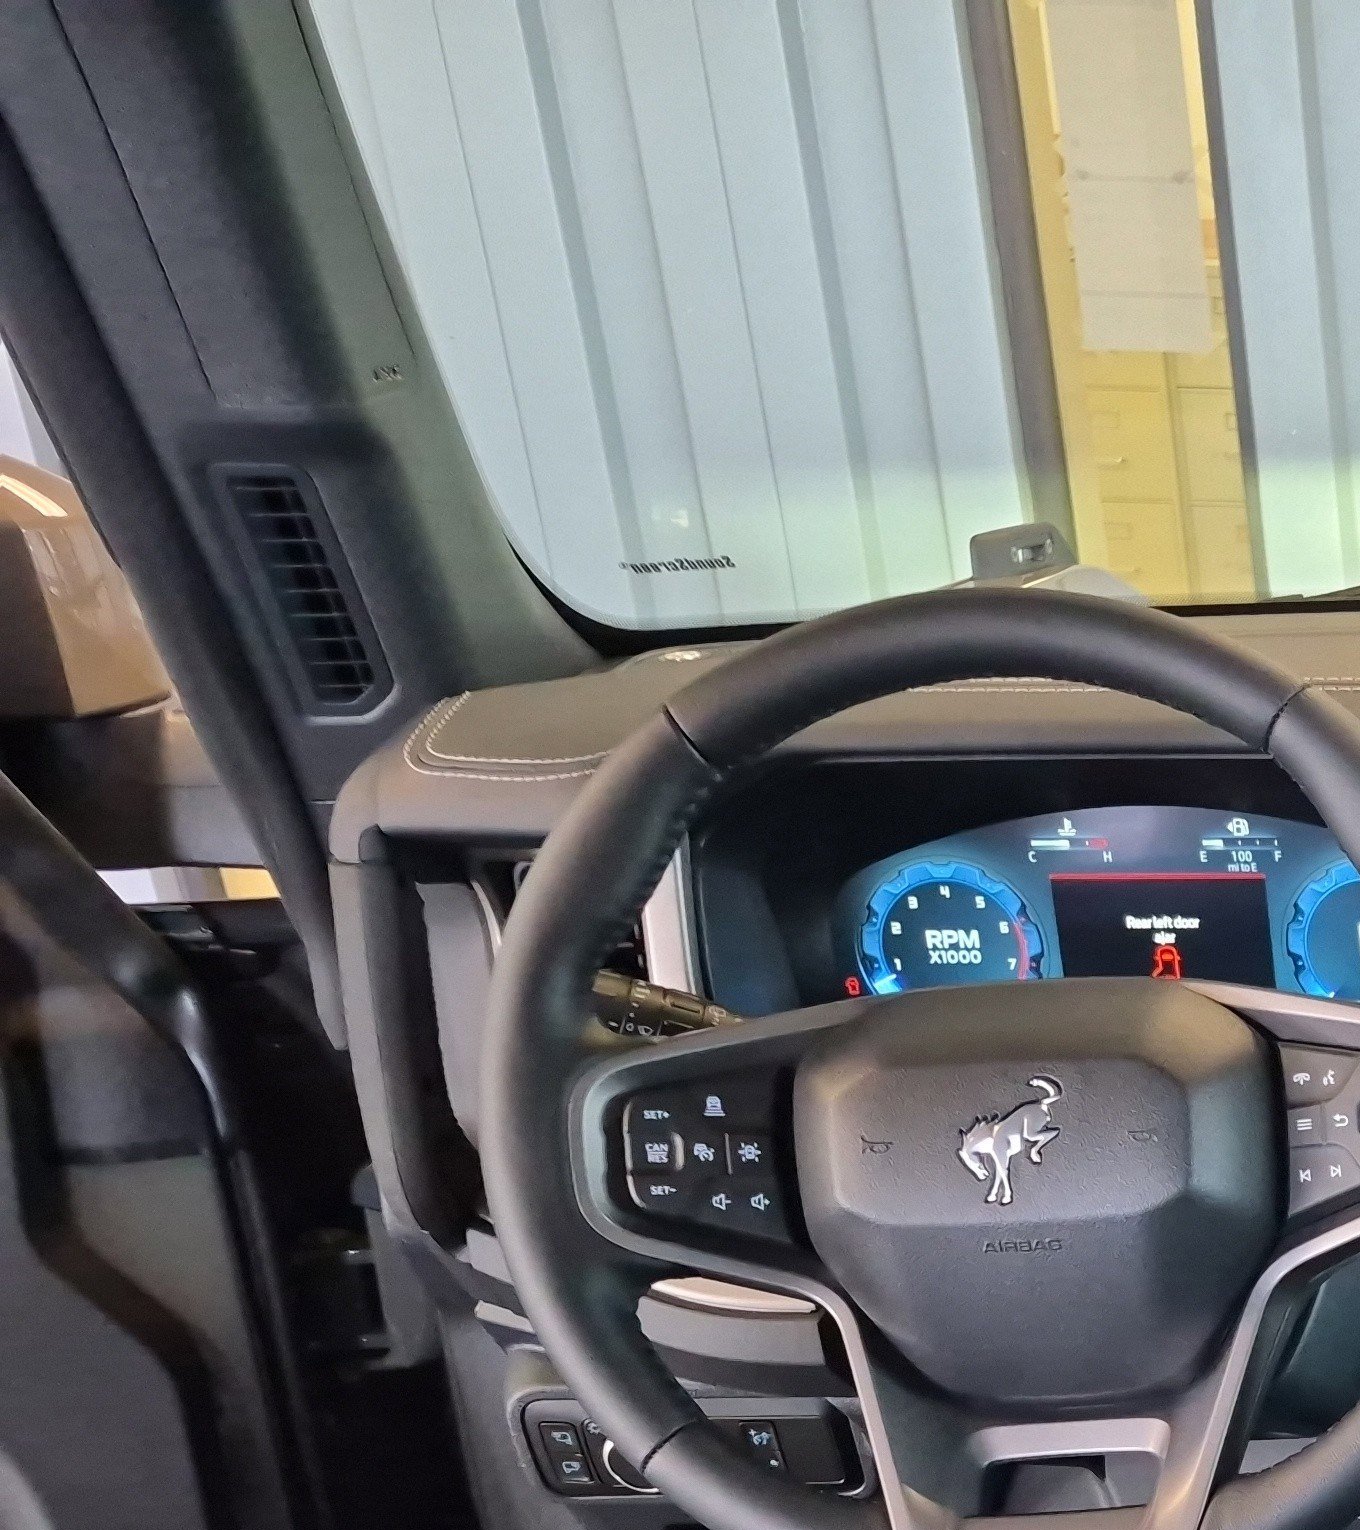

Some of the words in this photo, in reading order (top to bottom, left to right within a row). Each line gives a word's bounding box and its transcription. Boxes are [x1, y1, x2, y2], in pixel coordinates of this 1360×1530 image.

[1028, 852, 1037, 863] C
[1104, 852, 1112, 862] H
[1200, 852, 1207, 862] E
[1231, 851, 1252, 862] 100
[1275, 852, 1281, 862] F
[1241, 863, 1250, 872] to
[1251, 864, 1257, 872] E
[940, 885, 950, 898] 4
[908, 896, 918, 909] 3
[975, 896, 985, 909] 5
[891, 921, 901, 934] 2
[1000, 921, 1009, 934] 6
[1125, 916, 1152, 929] Rear
[1152, 915, 1172, 929] left
[1174, 916, 1200, 929] door
[925, 929, 980, 949] RPM
[929, 950, 982, 964] X1000
[894, 958, 901, 971] 1
[1008, 958, 1017, 970] 7
[643, 1110, 671, 1119] SET+
[645, 1143, 668, 1151] CAN
[983, 1239, 1062, 1253] AIRBAG
